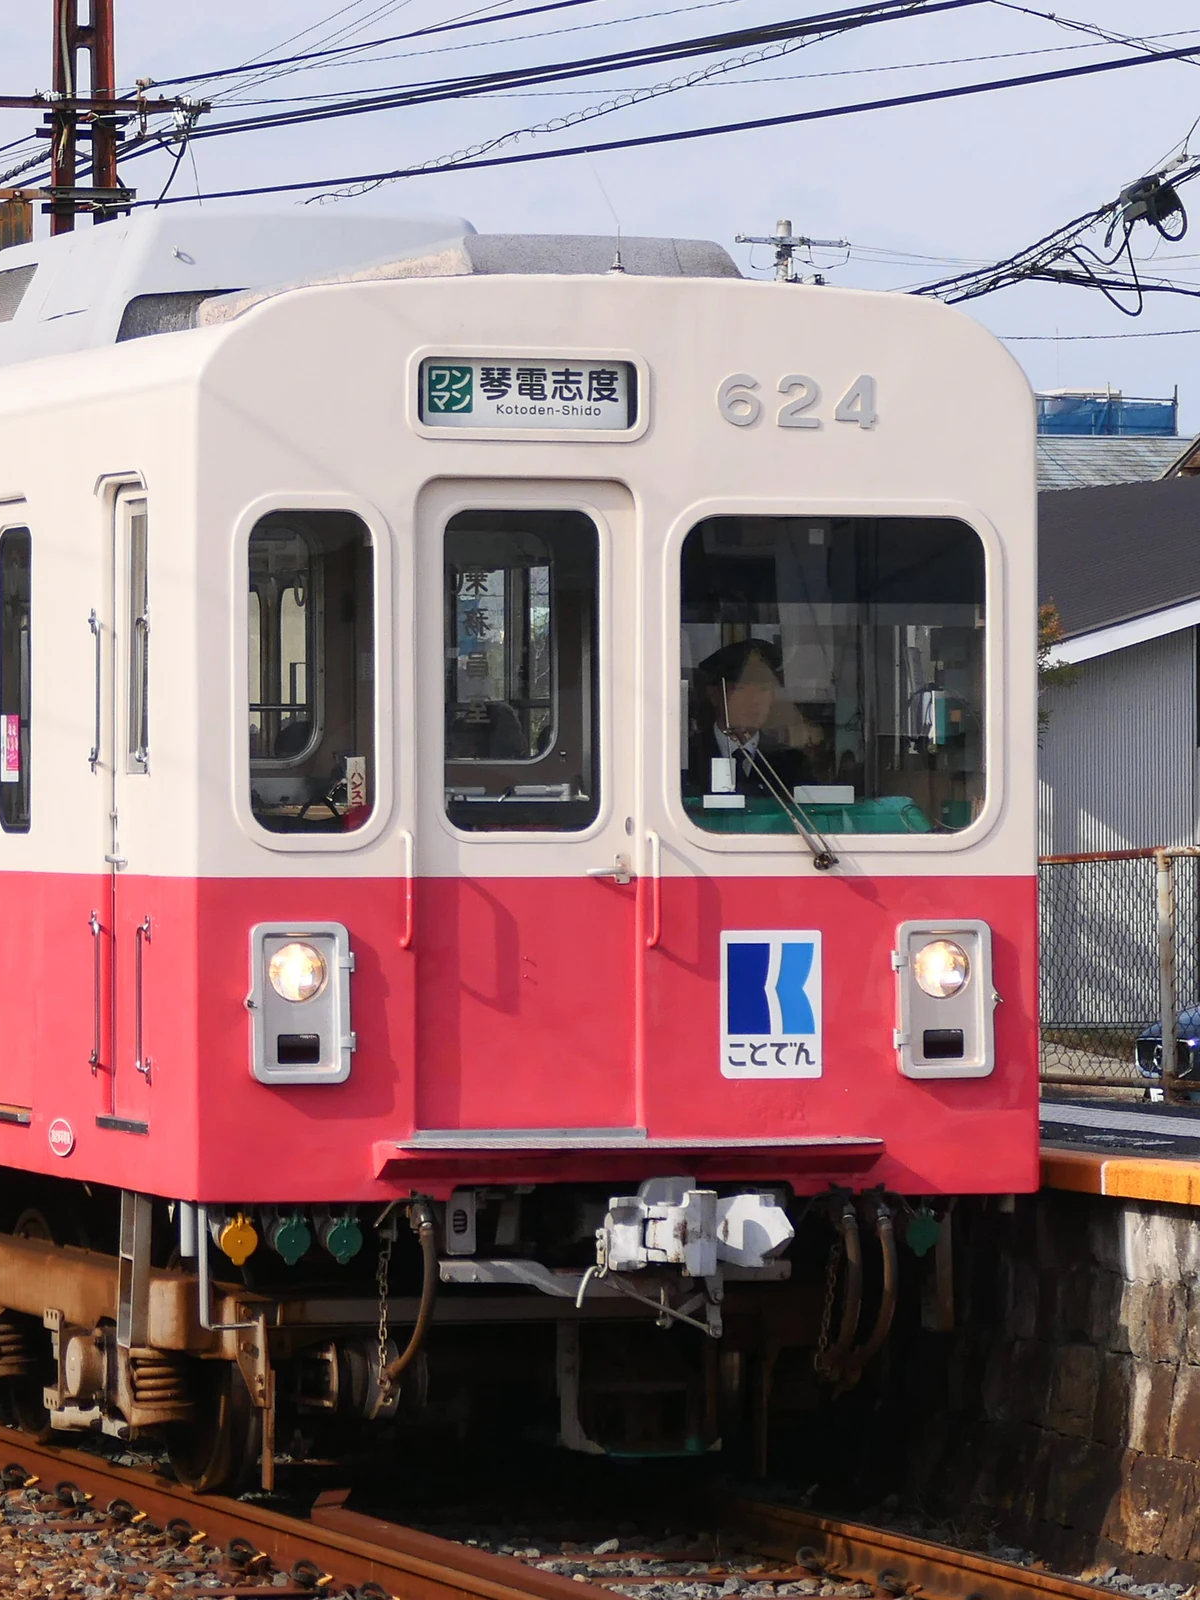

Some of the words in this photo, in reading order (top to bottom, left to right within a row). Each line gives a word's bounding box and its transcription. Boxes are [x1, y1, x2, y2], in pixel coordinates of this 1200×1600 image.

[431, 369, 471, 390] ワン
[479, 366, 620, 403] 琴電志度
[431, 390, 471, 412] マン
[496, 403, 602, 417] Kotoden-Shido
[716, 373, 879, 430] 624
[727, 1042, 816, 1067] ことでん
